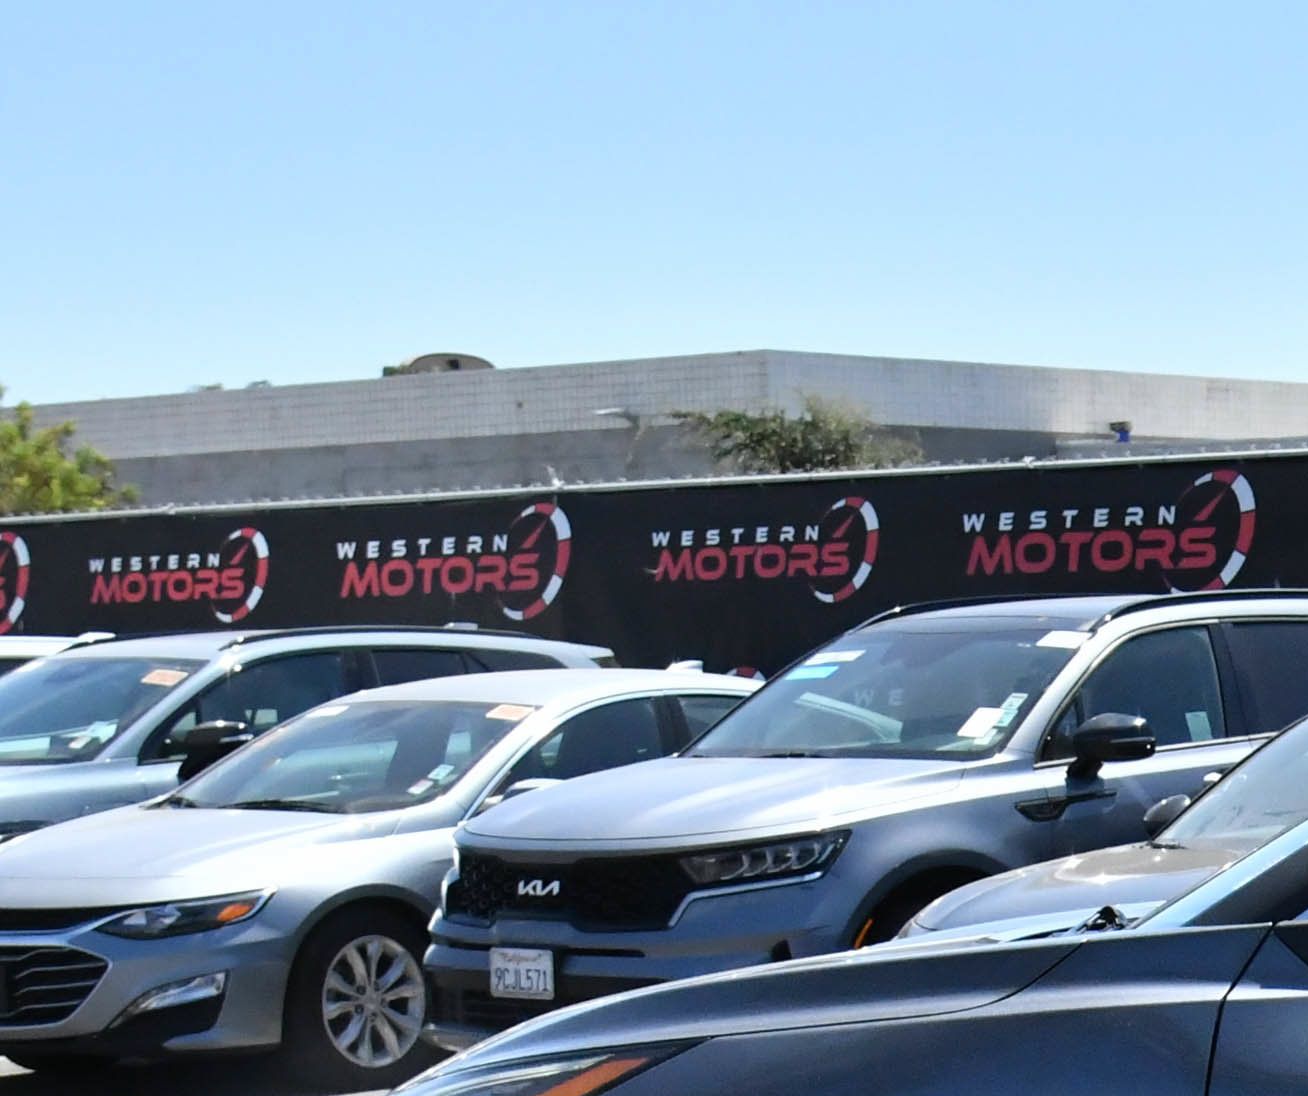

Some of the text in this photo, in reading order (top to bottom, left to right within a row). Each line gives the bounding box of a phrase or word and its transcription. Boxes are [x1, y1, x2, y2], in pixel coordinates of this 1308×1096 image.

[963, 506, 1176, 532] WESTERN
[336, 534, 508, 560] WESTERN
[652, 525, 819, 547] WESTERN
[89, 553, 220, 573] WESTERN
[655, 542, 850, 581] MOTORS
[966, 526, 1217, 576] MOTORS
[91, 567, 245, 603] MOTORS
[340, 553, 539, 598] MOTORS
[517, 879, 561, 896] KIA
